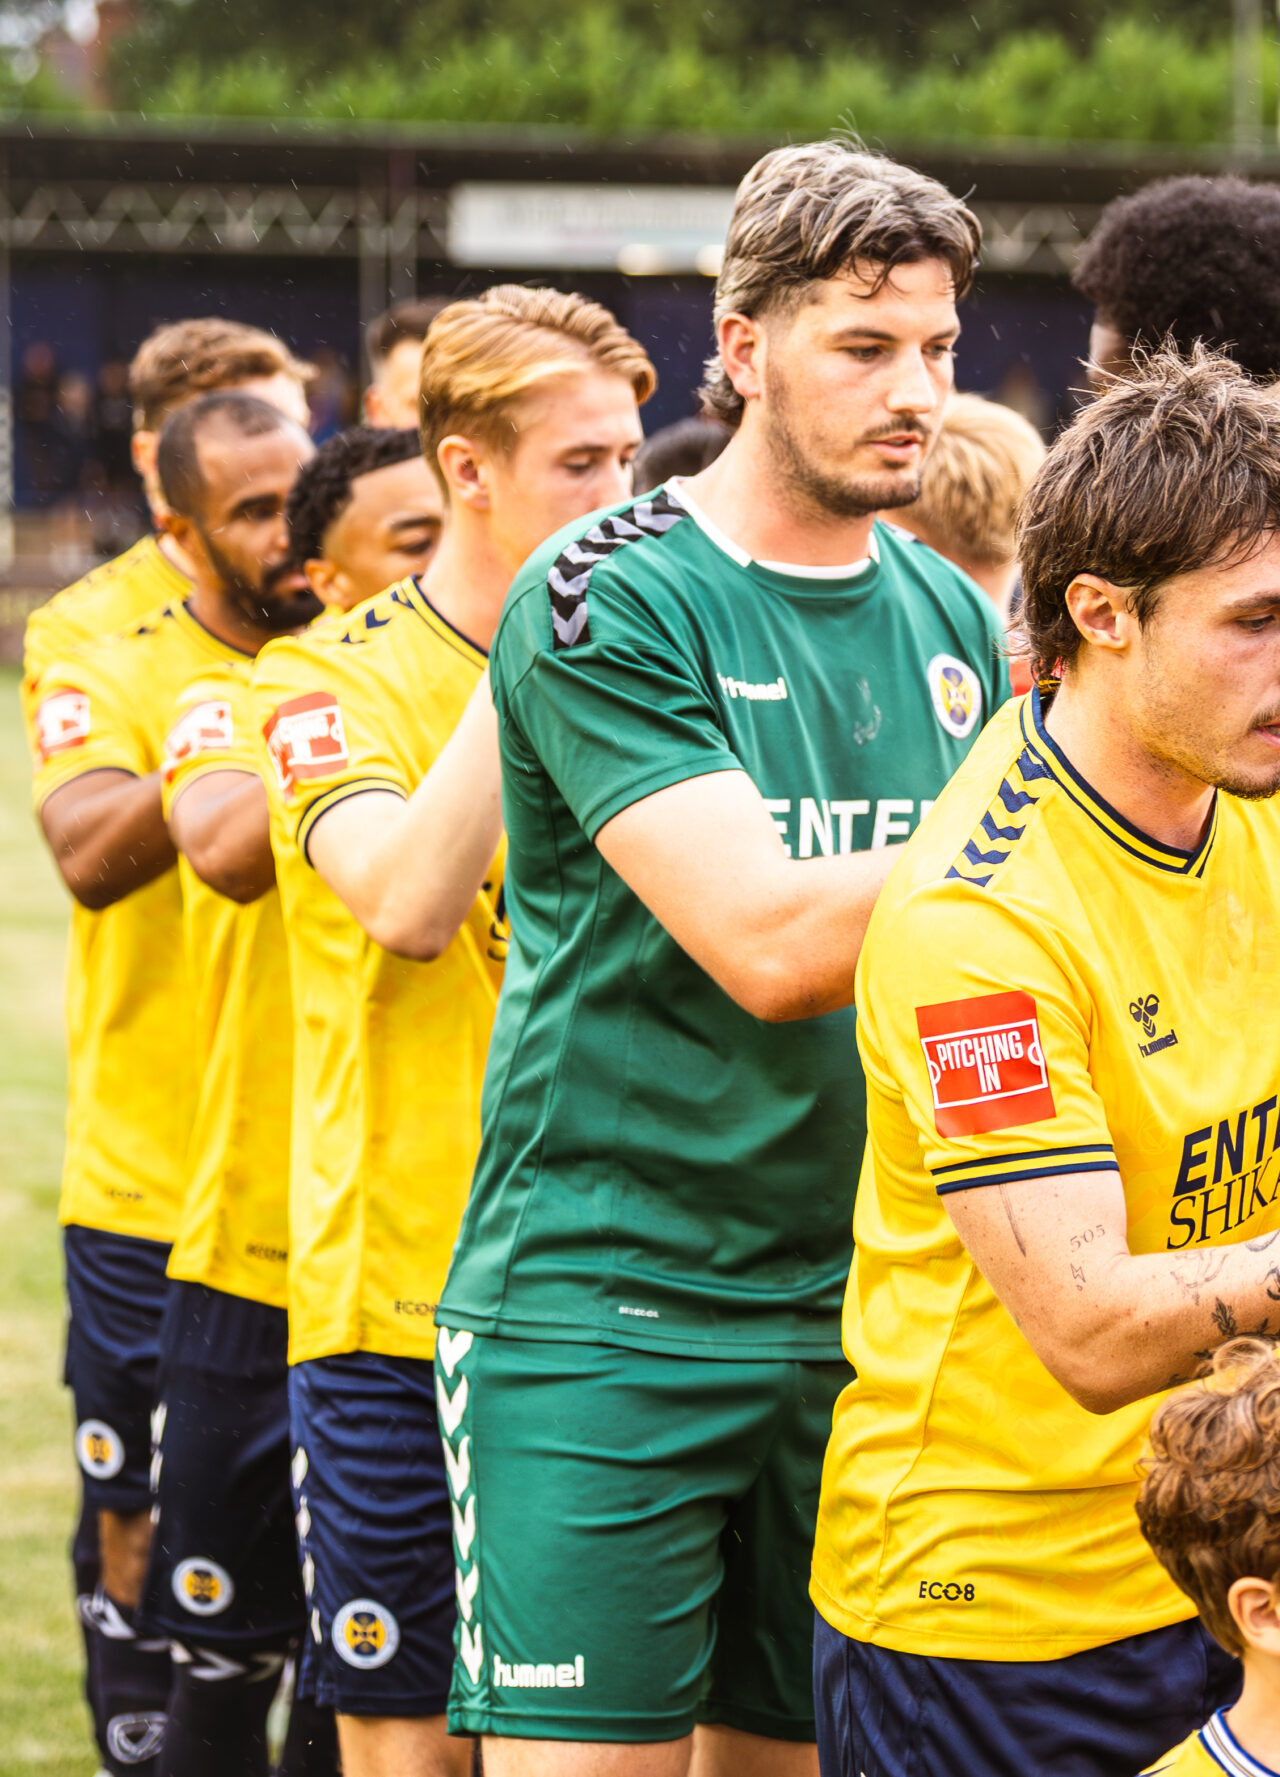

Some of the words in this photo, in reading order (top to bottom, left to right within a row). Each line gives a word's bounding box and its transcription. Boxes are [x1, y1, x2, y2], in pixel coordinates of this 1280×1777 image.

[936, 1031, 1024, 1072] PITCHING
[978, 1062, 1002, 1094] IN
[493, 1653, 585, 1688] hummel
